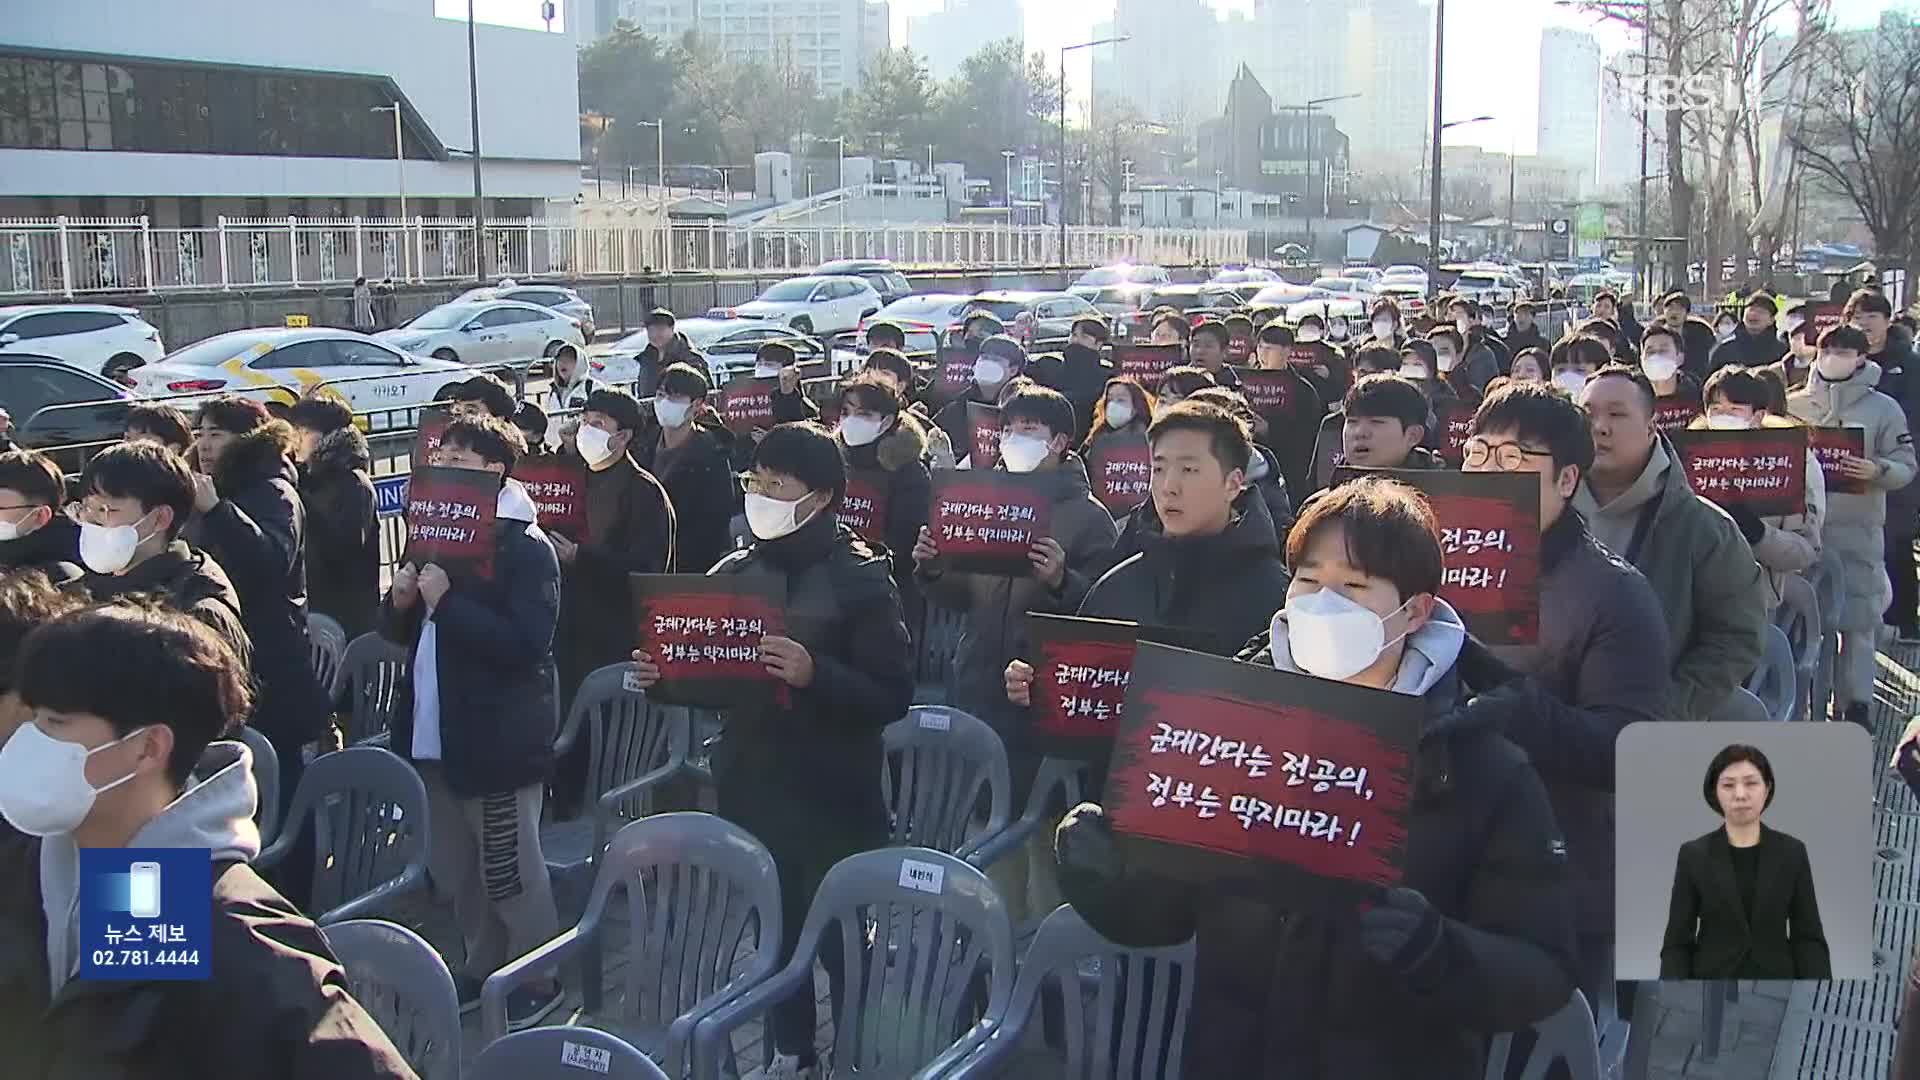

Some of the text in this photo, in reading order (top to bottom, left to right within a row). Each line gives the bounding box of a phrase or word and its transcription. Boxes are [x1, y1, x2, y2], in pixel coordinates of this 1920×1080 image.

[1441, 528, 1512, 554] 전공의,
[1060, 695, 1111, 720] 정부는
[1150, 722, 1374, 801] 군대간다는 전공의,
[1146, 773, 1222, 819] 정부는
